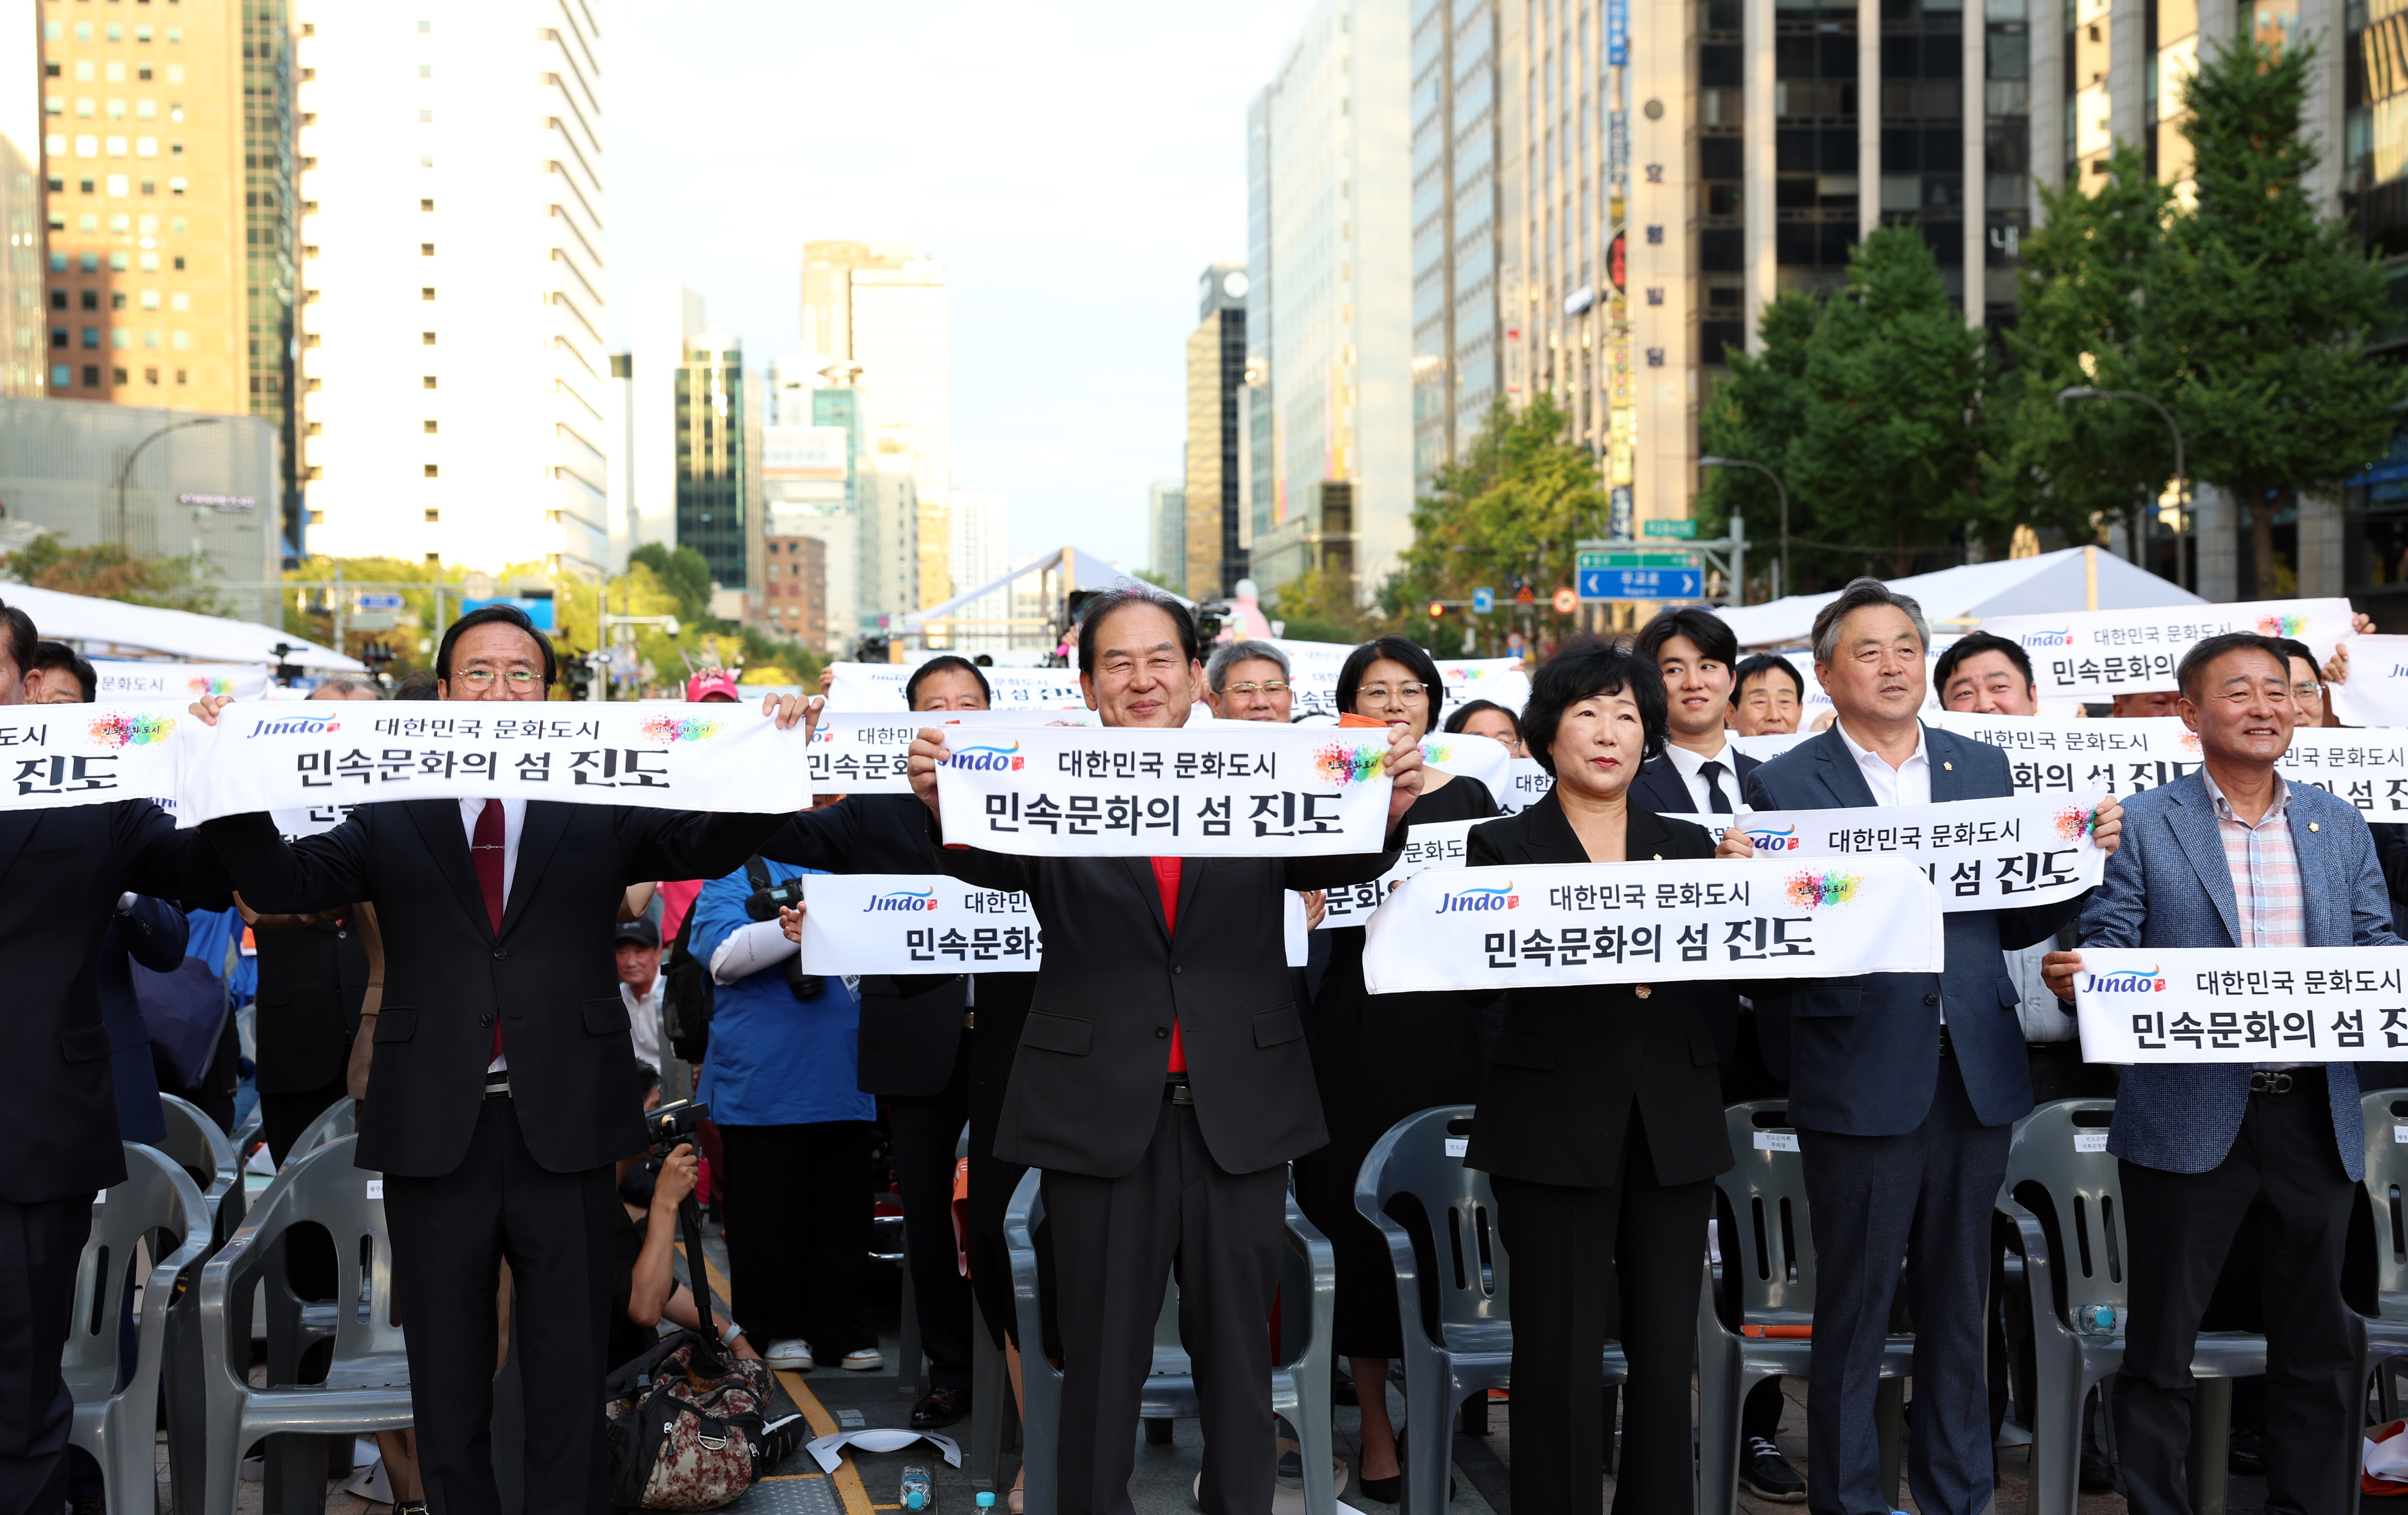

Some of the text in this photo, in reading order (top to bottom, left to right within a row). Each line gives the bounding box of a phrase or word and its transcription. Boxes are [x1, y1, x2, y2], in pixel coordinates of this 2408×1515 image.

[2021, 635, 2063, 648] Jindo
[2094, 622, 2232, 646] 대한민국 문화도시
[2053, 654, 2177, 686] 민속문화의
[102, 676, 164, 692] 문화도시
[247, 720, 325, 738] Jindo
[375, 718, 600, 740] 대한민국 문화도시
[858, 727, 919, 745] 대한민
[1974, 730, 2147, 751] 대한민국 문화도시
[297, 748, 670, 788] 민속문화의 섬 진도
[1059, 751, 1275, 779] 대한민국 문화도시
[2274, 747, 2404, 768] 민국 문화도시
[13, 756, 118, 796] 진도
[1516, 774, 1555, 793] 대한
[2347, 780, 2374, 810] 섬
[986, 791, 1344, 837] 민속문화의 섬 진도
[1829, 818, 2020, 853] 대한민국 문화도시
[1950, 860, 1981, 897] 섬
[1996, 848, 2079, 895] 진도
[863, 895, 925, 912] Jindo
[965, 892, 1031, 913] 대한민
[1435, 893, 1505, 914] Jindo
[1550, 881, 1750, 911] 대한민국 문화도시
[1484, 916, 1815, 968] 민속문화의 섬 진도
[2082, 974, 2152, 993] Jindo
[2196, 968, 2402, 996] 대한민국 문화도시
[2132, 1010, 2316, 1049] 민속문화의
[2330, 1010, 2364, 1048] 섬
